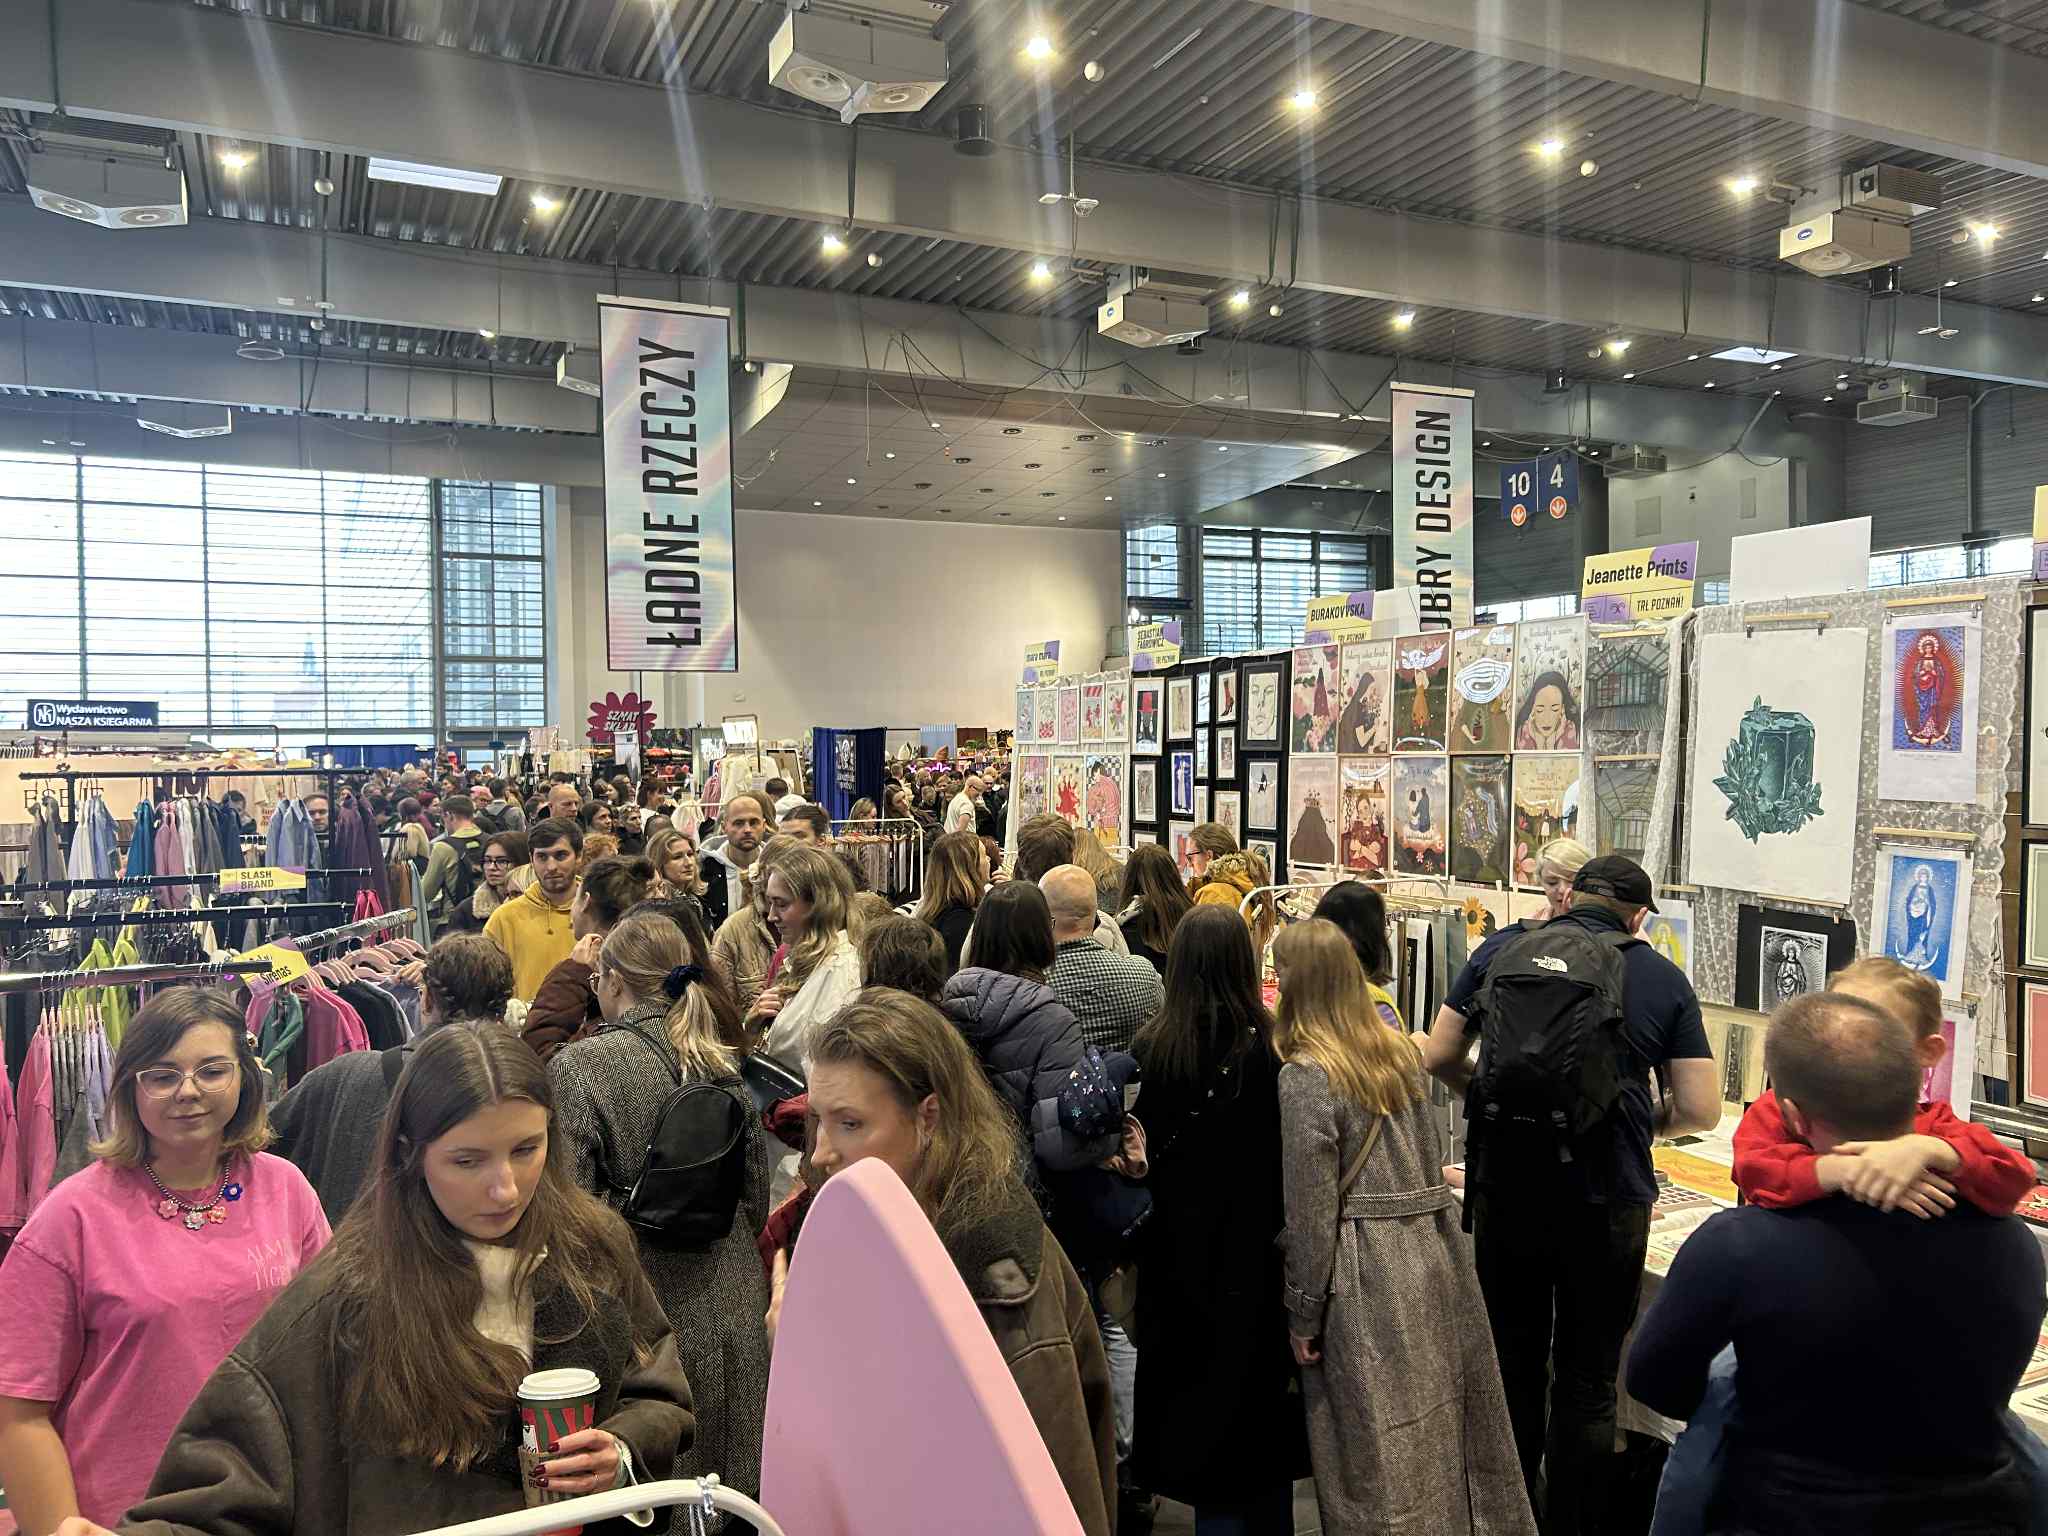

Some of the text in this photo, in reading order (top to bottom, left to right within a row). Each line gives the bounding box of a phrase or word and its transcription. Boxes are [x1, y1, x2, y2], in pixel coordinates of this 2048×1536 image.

[1415, 410, 1452, 533] DESIGN
[1550, 464, 1564, 488] 4
[638, 337, 702, 649] ŁADNE RZECZY
[1508, 471, 1530, 497] 10
[1586, 558, 1688, 585] Jeanette Prints
[56, 704, 128, 716] Wydawnictwo
[606, 711, 639, 721] SZMAT
[56, 716, 92, 726] NASZA
[240, 871, 272, 880] SLASH
[240, 879, 274, 889] BRAND
